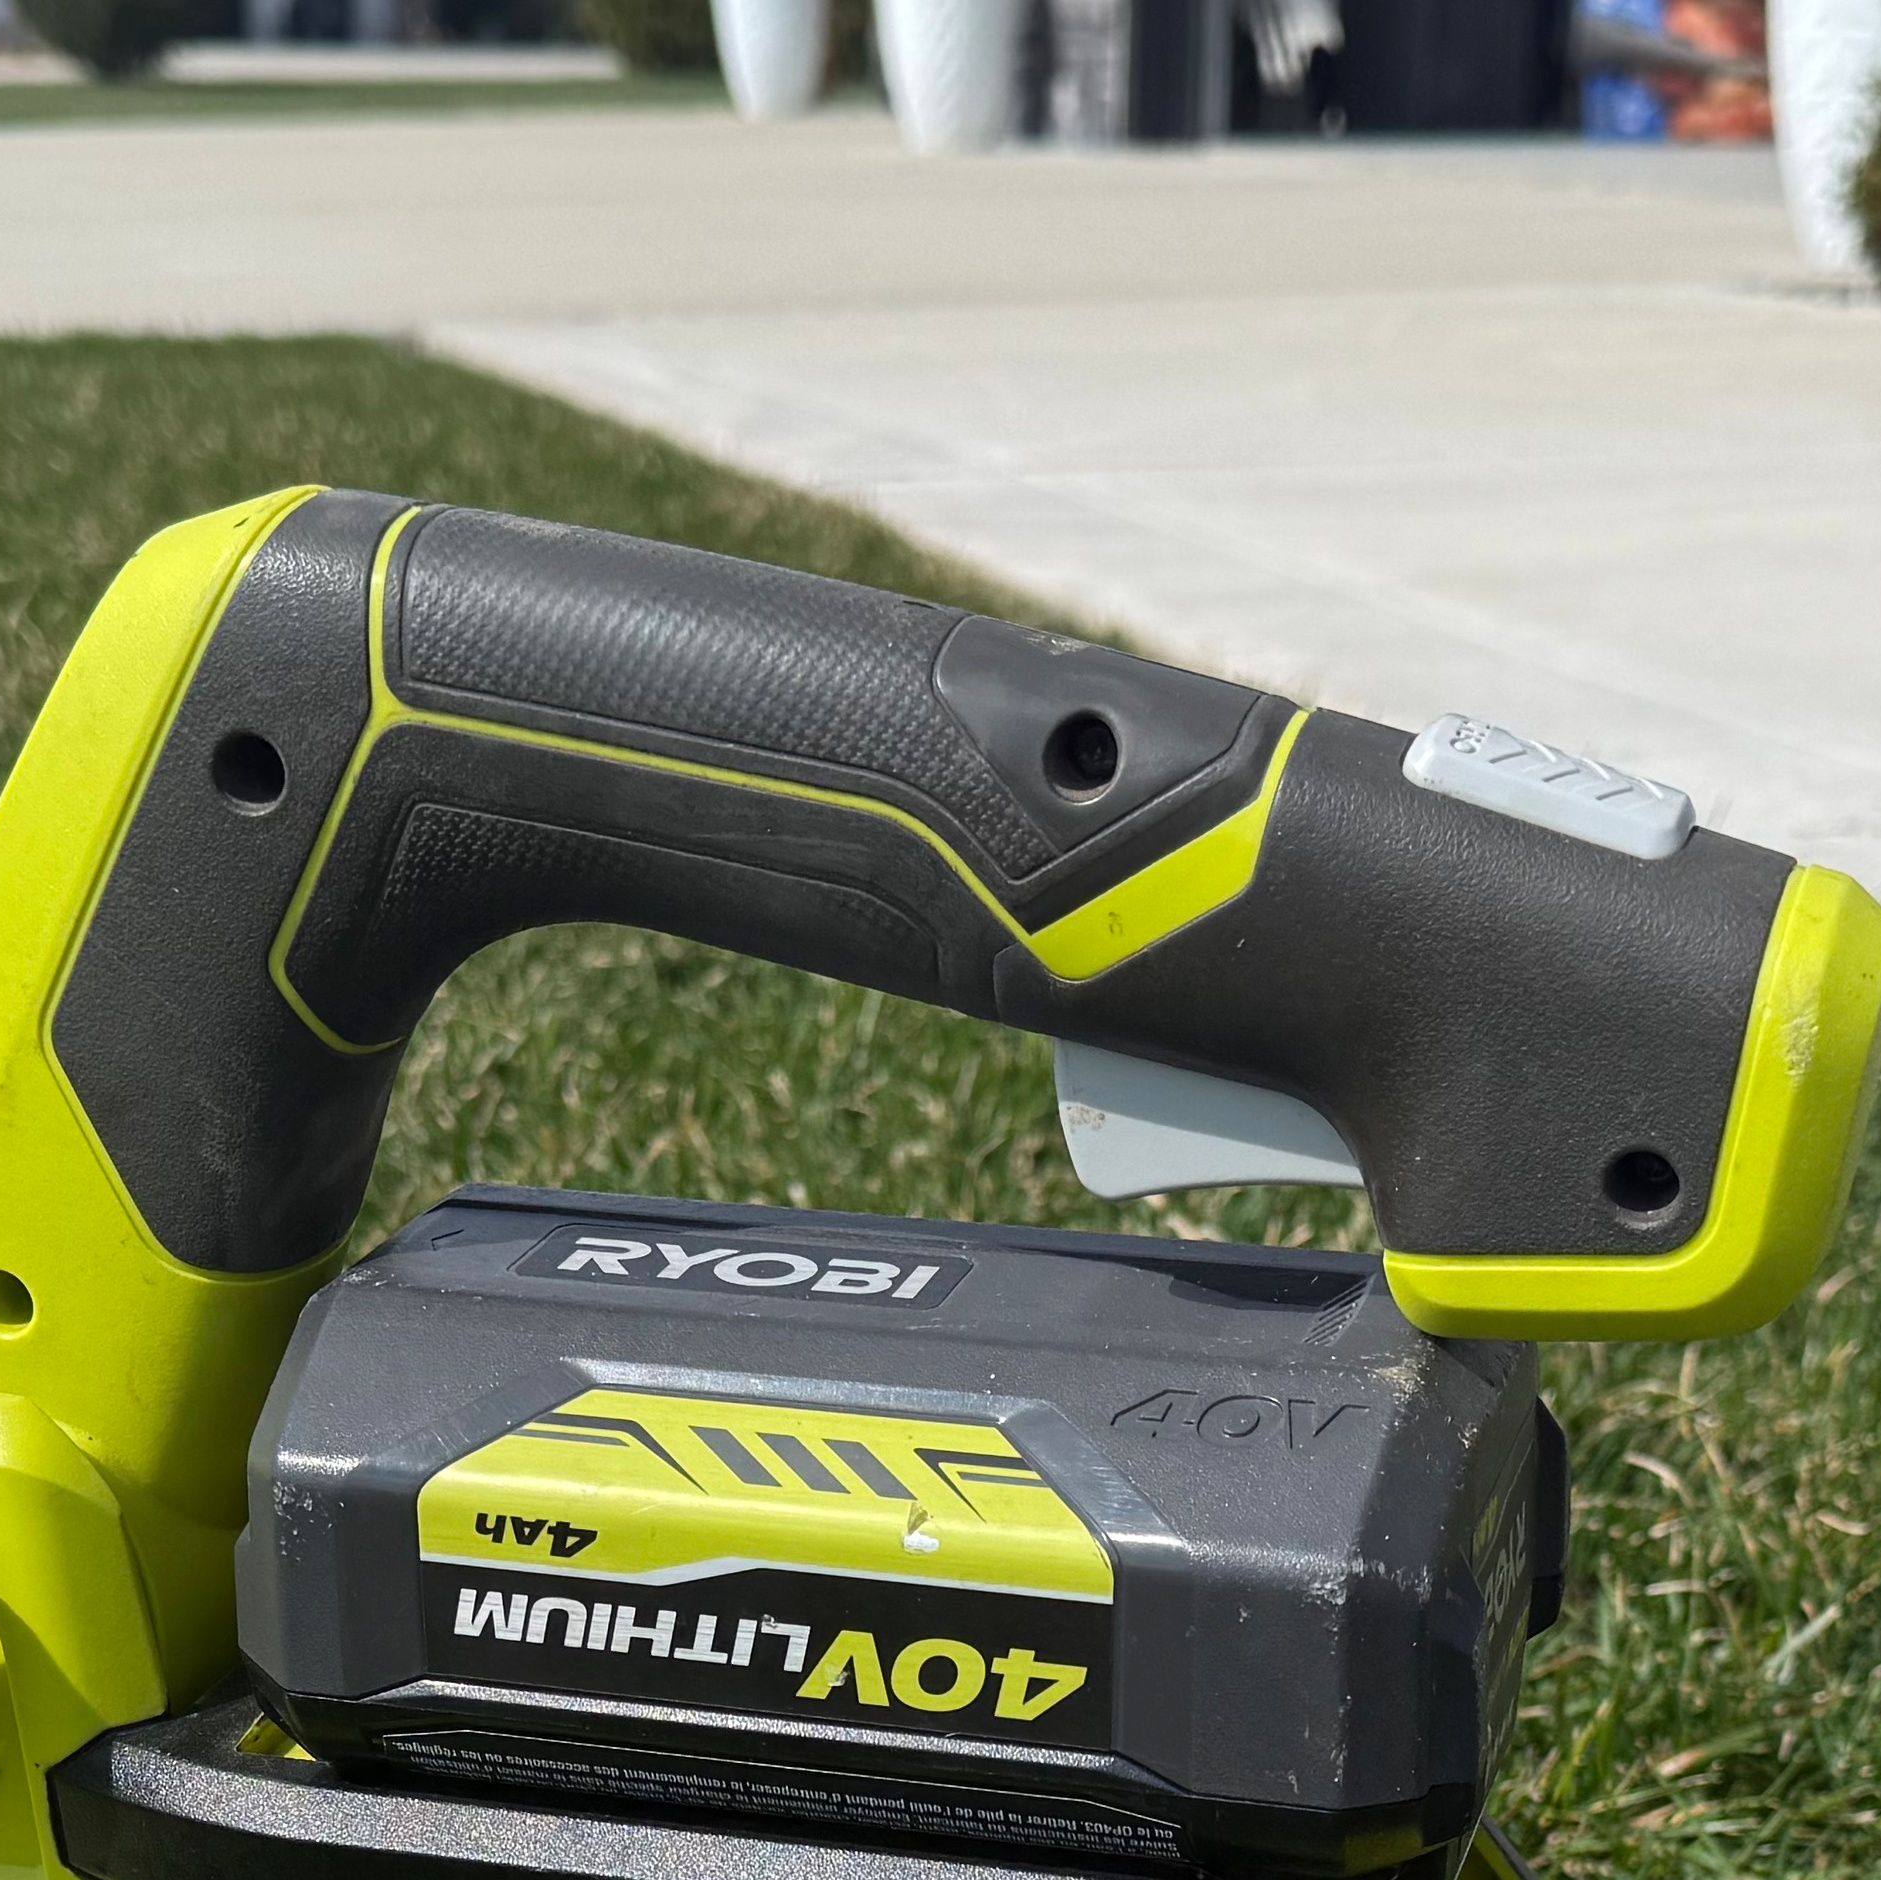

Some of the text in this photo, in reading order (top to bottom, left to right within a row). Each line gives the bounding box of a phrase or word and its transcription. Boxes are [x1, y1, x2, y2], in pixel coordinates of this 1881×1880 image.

[556, 1236, 939, 1300] RYOBI
[1112, 1388, 1370, 1450] 40V
[474, 1511, 598, 1559] 4Ah
